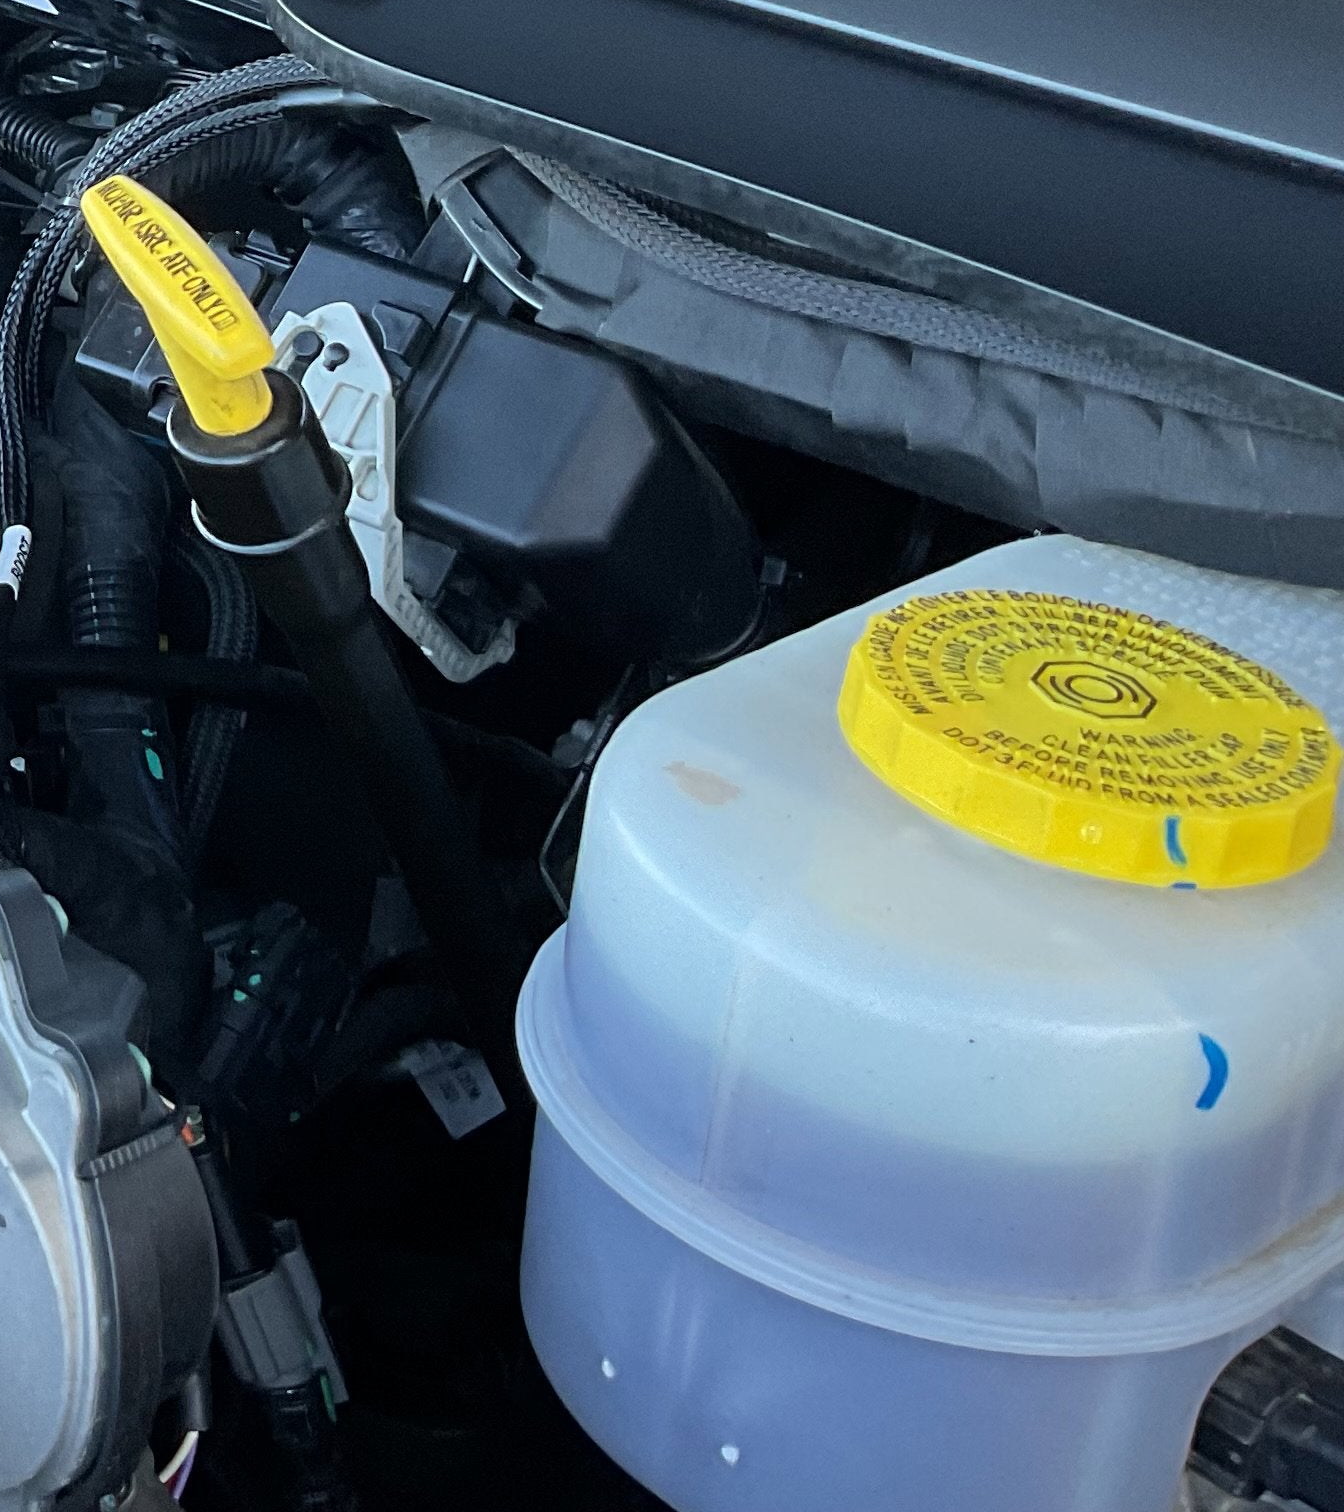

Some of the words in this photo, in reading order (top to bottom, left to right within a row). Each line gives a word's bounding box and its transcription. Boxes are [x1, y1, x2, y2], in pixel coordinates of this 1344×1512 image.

[95, 180, 144, 225] MOPAR
[160, 251, 198, 278] ATF
[181, 275, 226, 315] ONLY
[972, 589, 1004, 601] LE
[1007, 590, 1129, 619] BOUCHON
[913, 629, 938, 647] LE
[1012, 606, 1119, 631] UTILISER
[965, 622, 1005, 643] DOT
[1008, 621, 1027, 634] 3
[1029, 621, 1187, 667] PROVENANT
[977, 637, 1065, 685] CONTENANT
[1128, 625, 1269, 701] UNIQUEMENT
[876, 664, 903, 681] EN
[904, 662, 953, 704] AVANT
[886, 685, 933, 715] MISE
[943, 727, 996, 754] DOT
[994, 753, 1014, 765] 3
[1016, 761, 1092, 791] FLUID
[1101, 782, 1178, 807] FROM
[1186, 793, 1205, 809] A
[1205, 781, 1291, 809] SEALED
[984, 729, 1088, 774] BEFORE
[1231, 755, 1276, 780] USE
[1258, 727, 1291, 761] ONLY
[1041, 734, 1136, 766] CLEAN
[1137, 748, 1222, 770] FILLER
